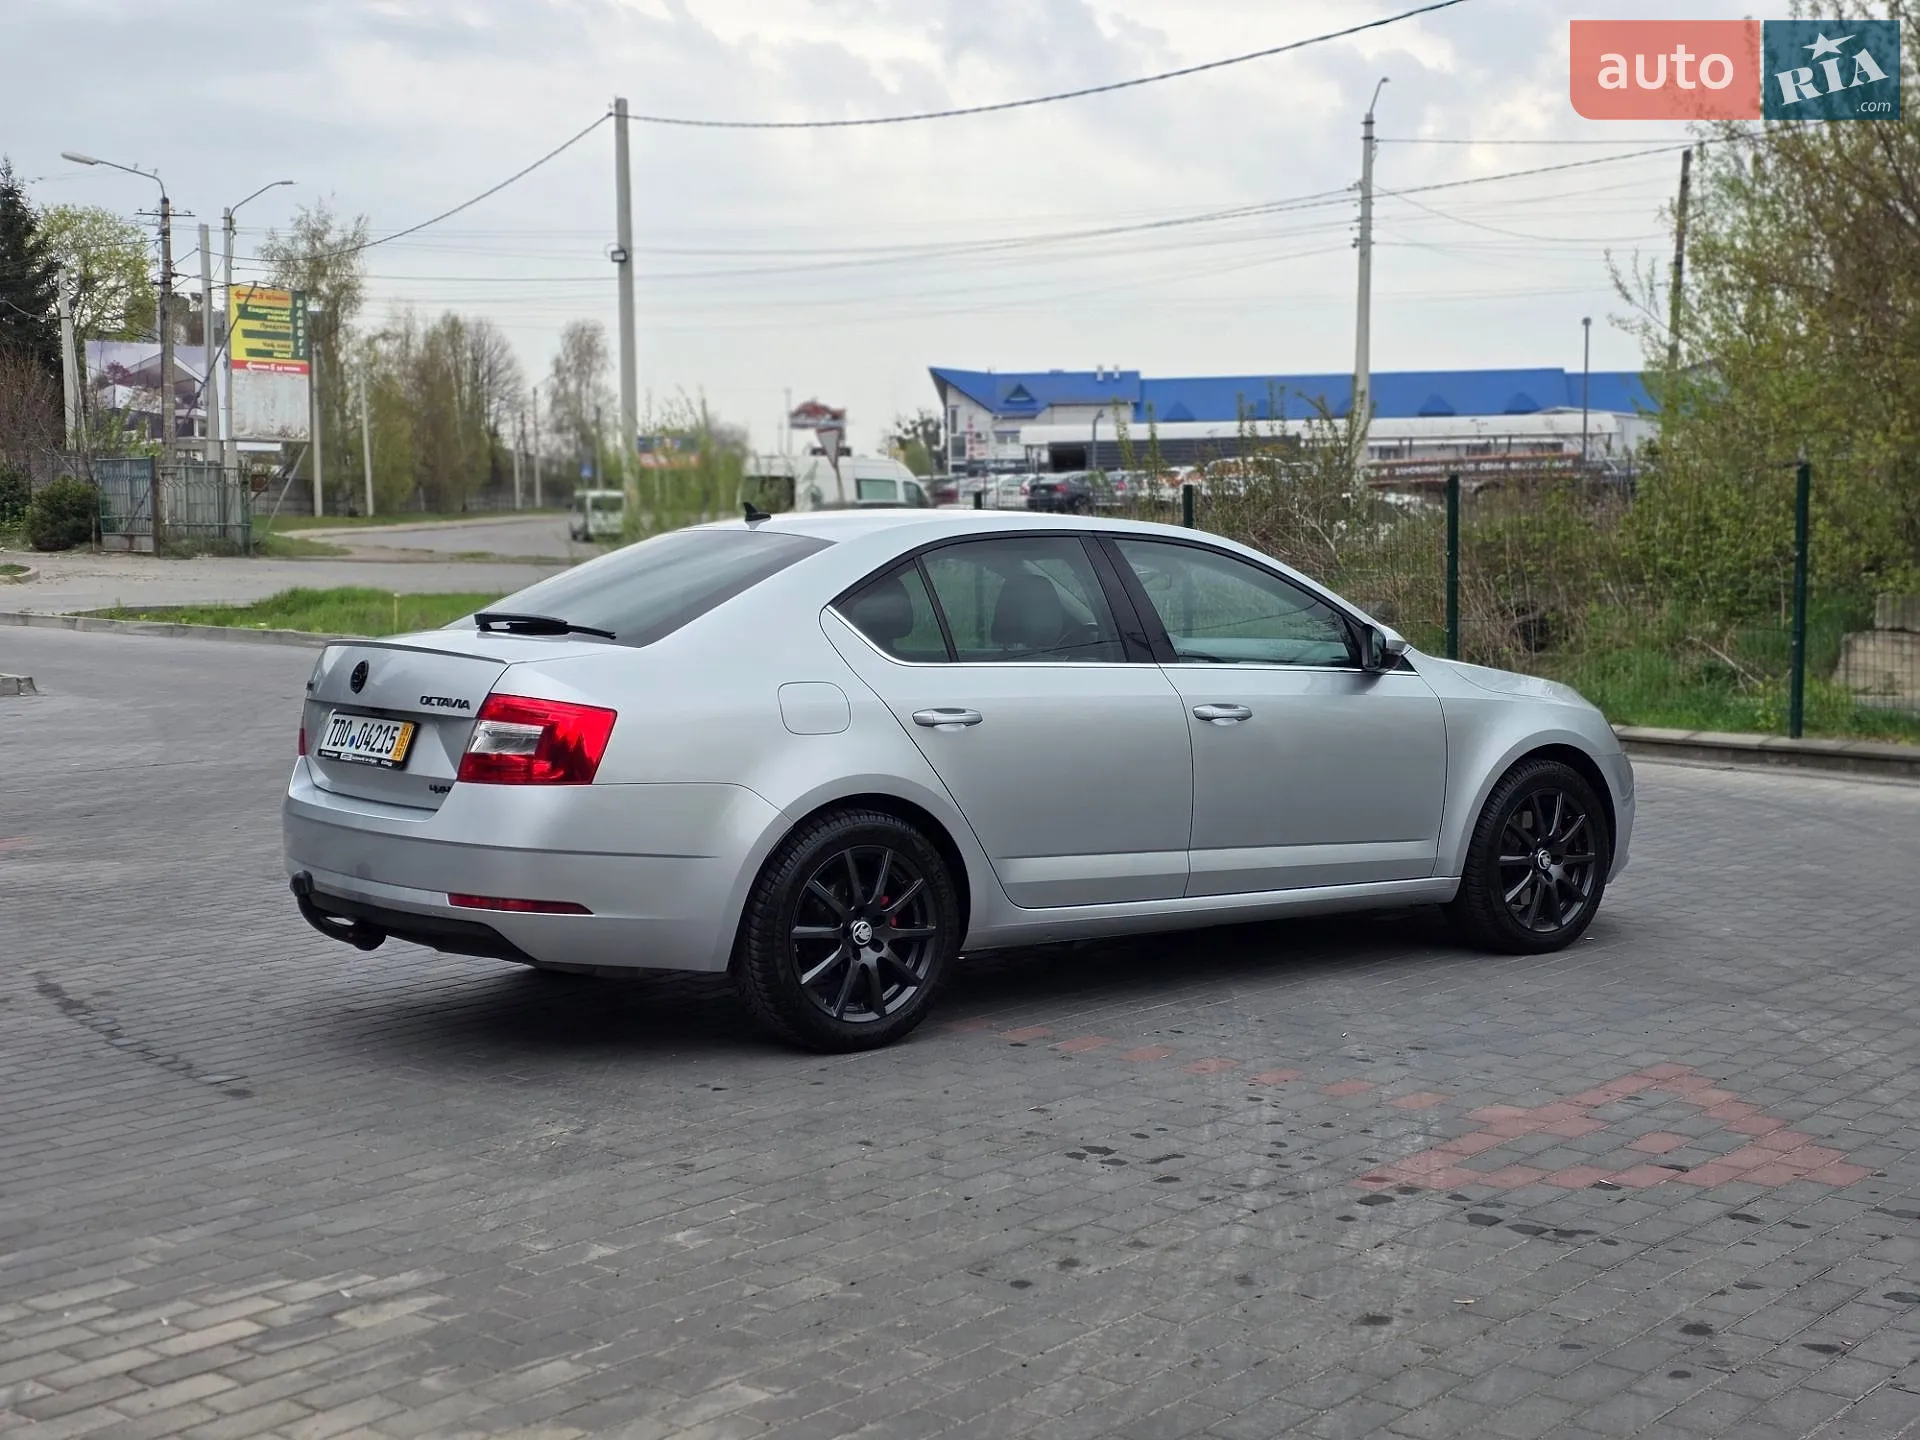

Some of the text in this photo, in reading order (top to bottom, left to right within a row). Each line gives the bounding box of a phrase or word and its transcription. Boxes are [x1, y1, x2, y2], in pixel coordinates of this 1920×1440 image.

[420, 695, 470, 710] OCTAVIA
[327, 718, 353, 747] TDO
[355, 722, 399, 755] 04215
